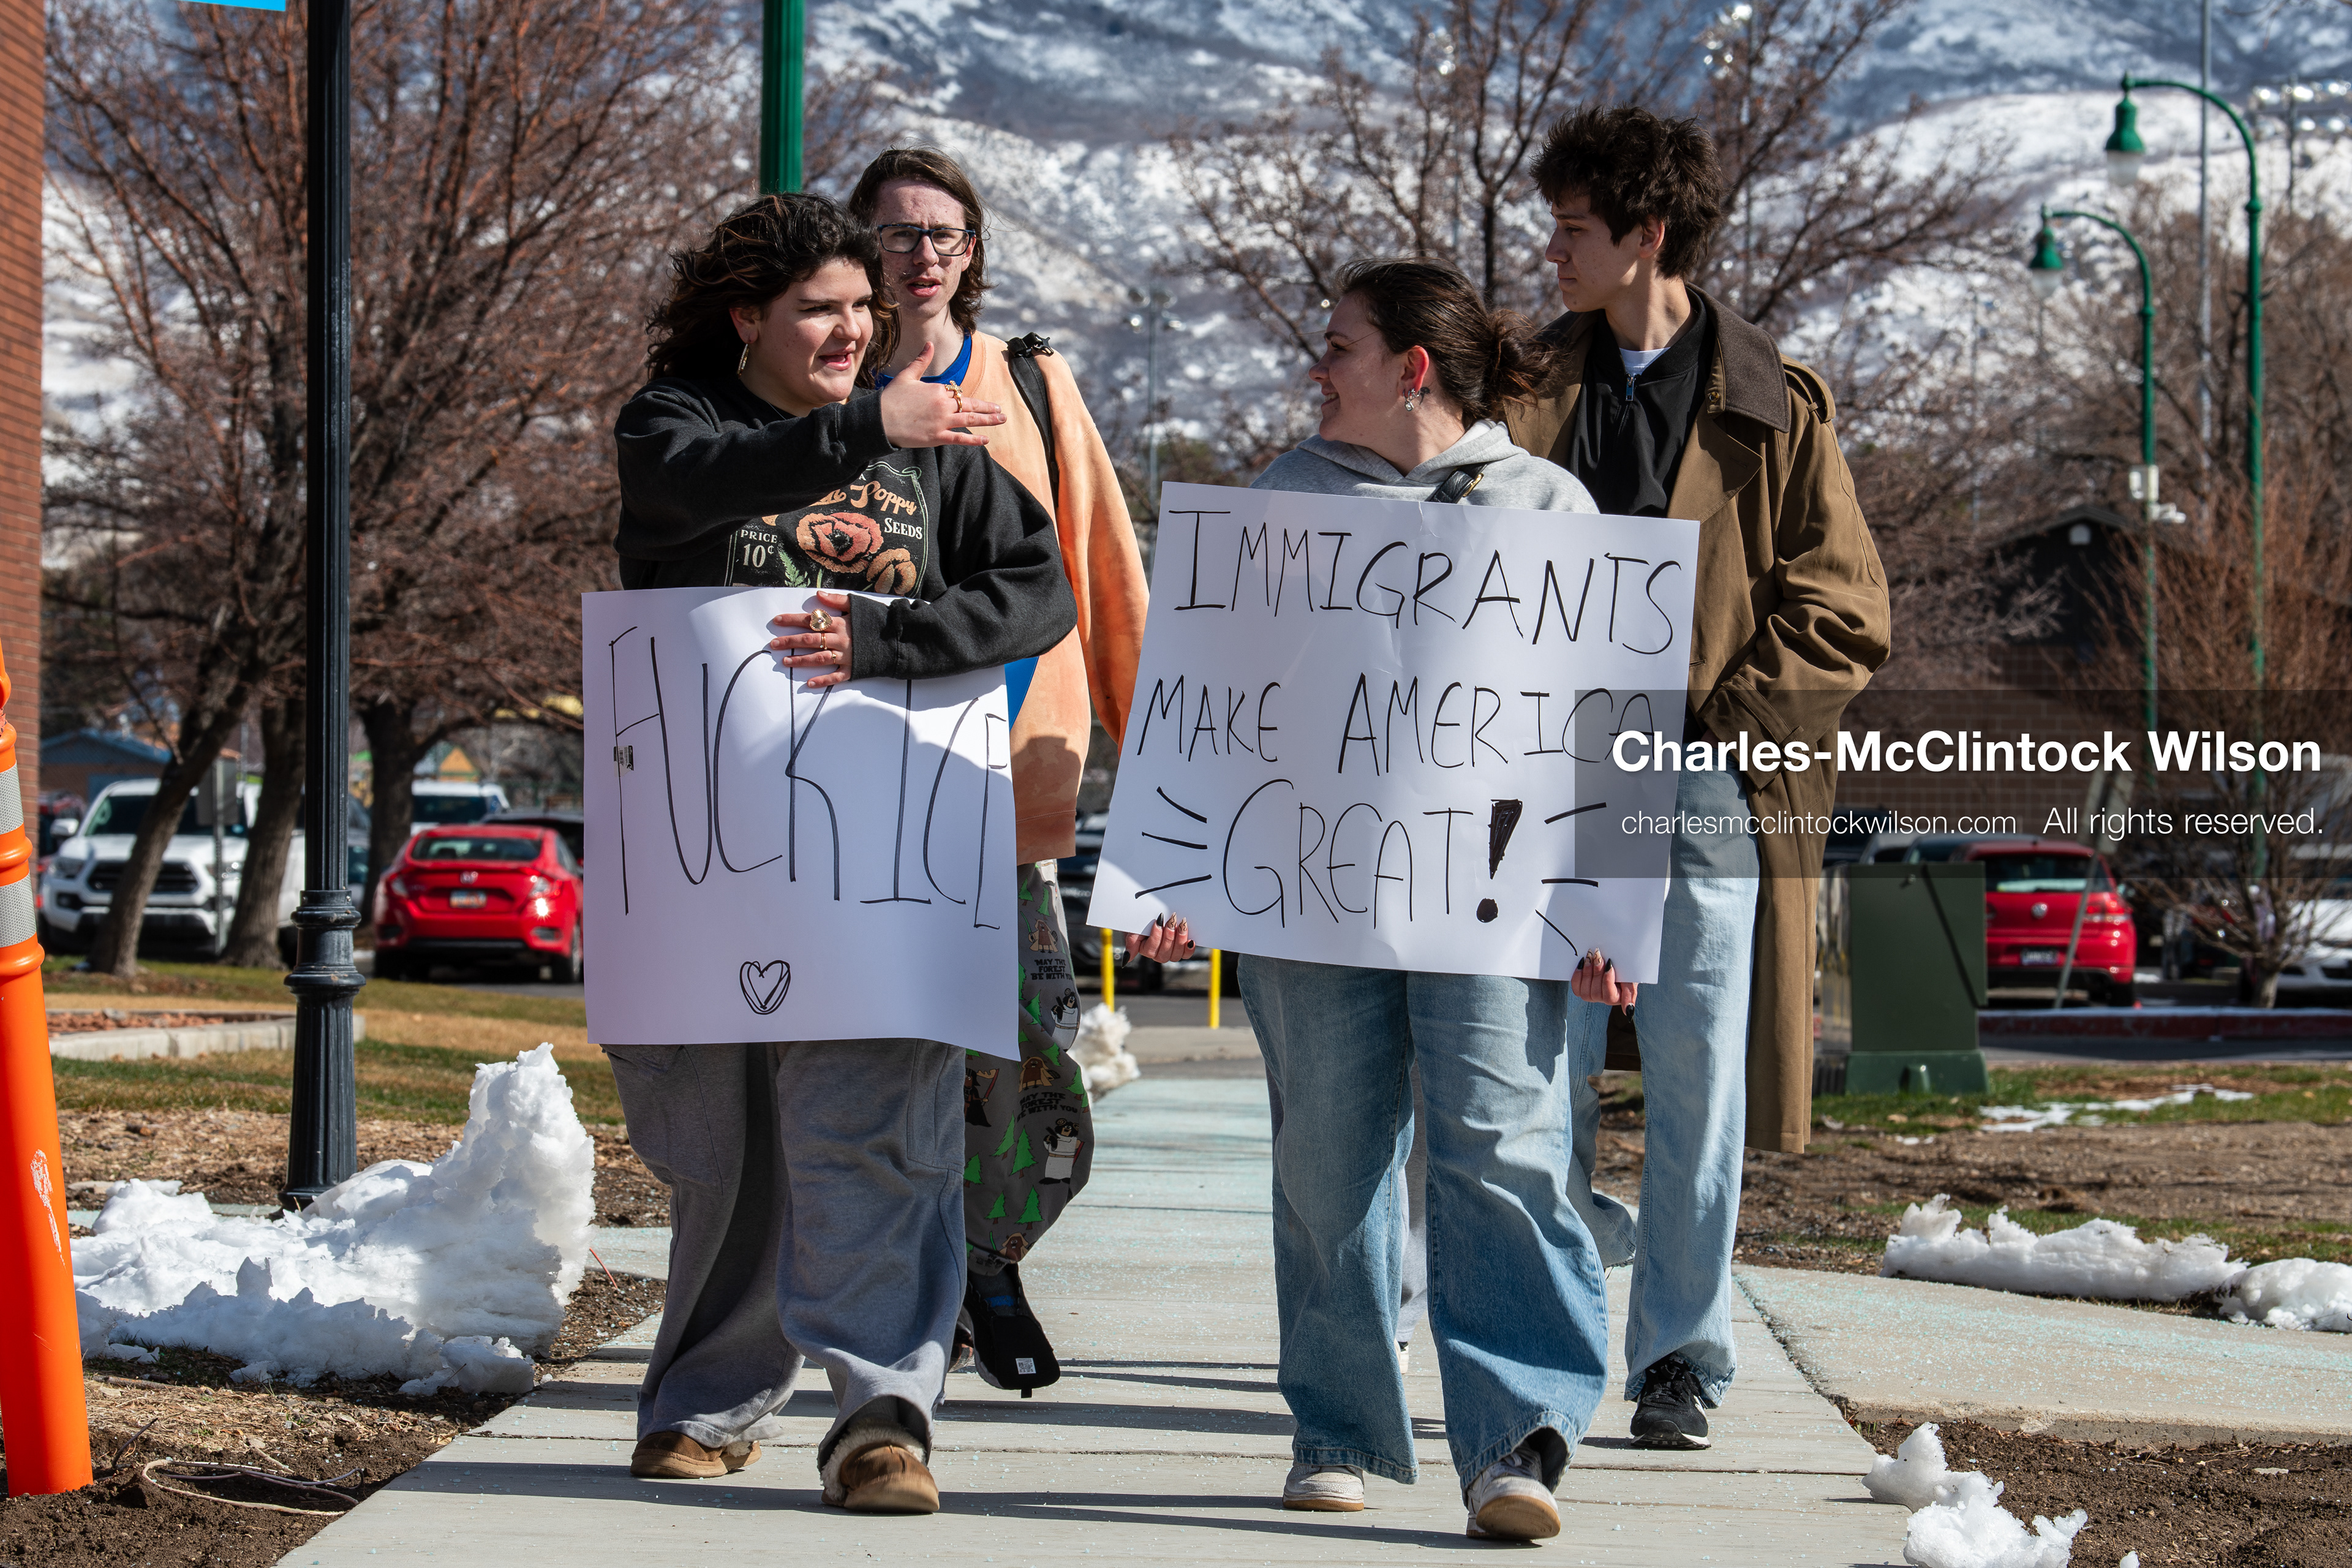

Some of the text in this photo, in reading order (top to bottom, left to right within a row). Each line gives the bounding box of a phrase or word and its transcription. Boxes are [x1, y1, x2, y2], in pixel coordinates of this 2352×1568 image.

[850, 481, 917, 515] Poppy
[741, 529, 778, 543] PRICE
[743, 543, 775, 568] 10¢
[1169, 510, 1682, 655] IMMIGRANTS
[1137, 672, 1655, 776] MAKE AMERICA
[609, 626, 840, 915] FUCK
[1223, 778, 1523, 929] GREAT!
[1028, 1104, 1057, 1114] WITH
[1060, 1105, 1078, 1114] YOU
